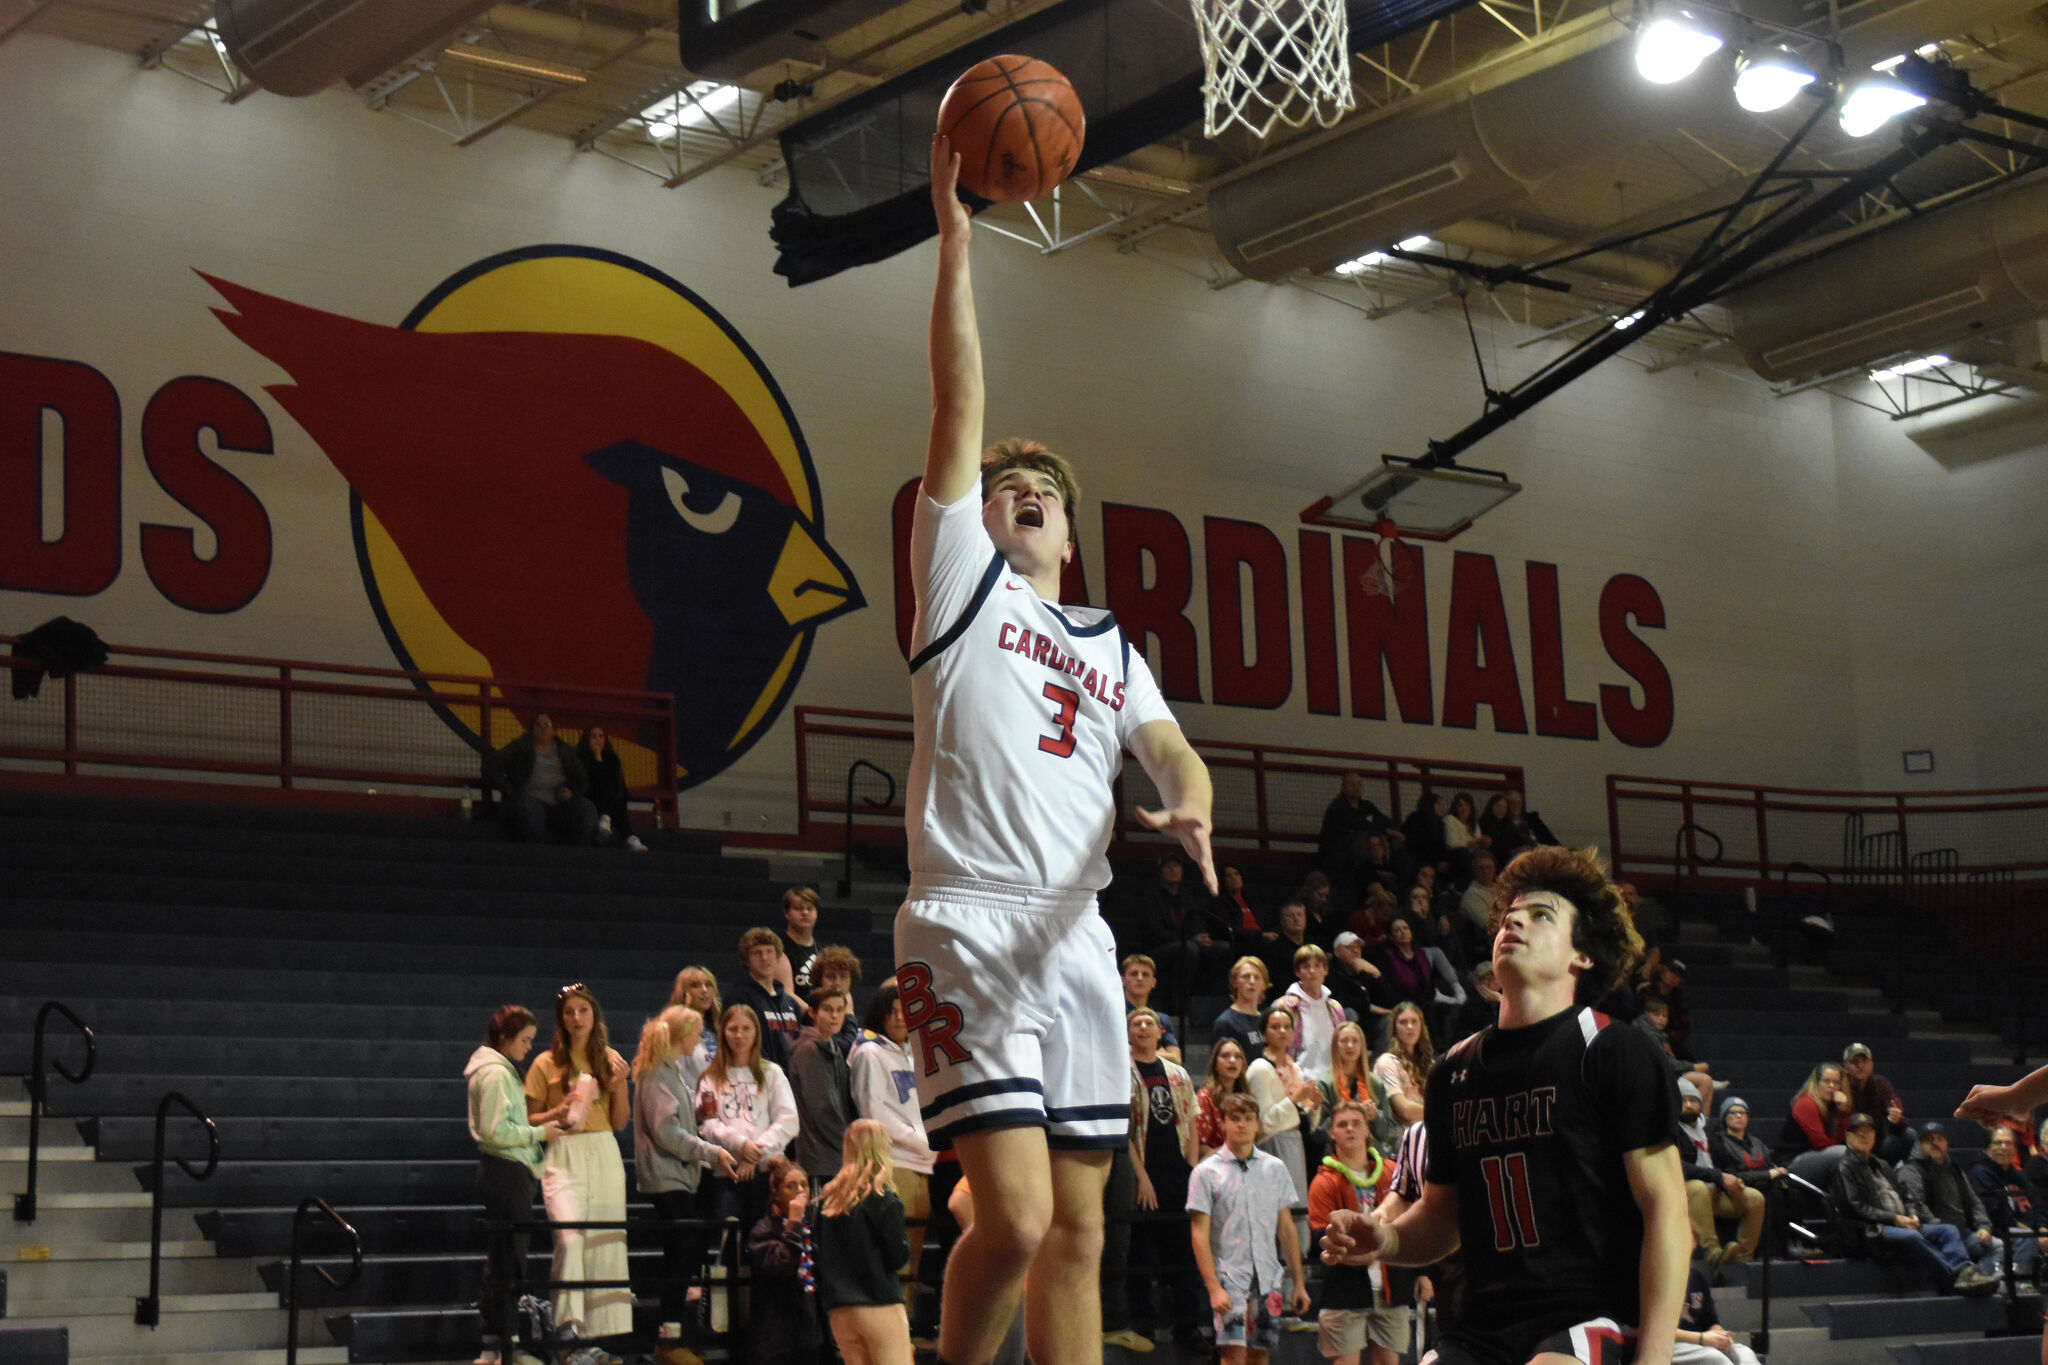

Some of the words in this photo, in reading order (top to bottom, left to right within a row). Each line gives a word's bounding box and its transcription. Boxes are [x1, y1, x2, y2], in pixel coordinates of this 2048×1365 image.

[892, 477, 1674, 748] RDINALS
[998, 621, 1126, 712] CARDNALS
[1038, 680, 1081, 759] 3
[896, 961, 973, 1077] BR
[1453, 1086, 1556, 1149] HART
[1480, 1152, 1540, 1251] 11
